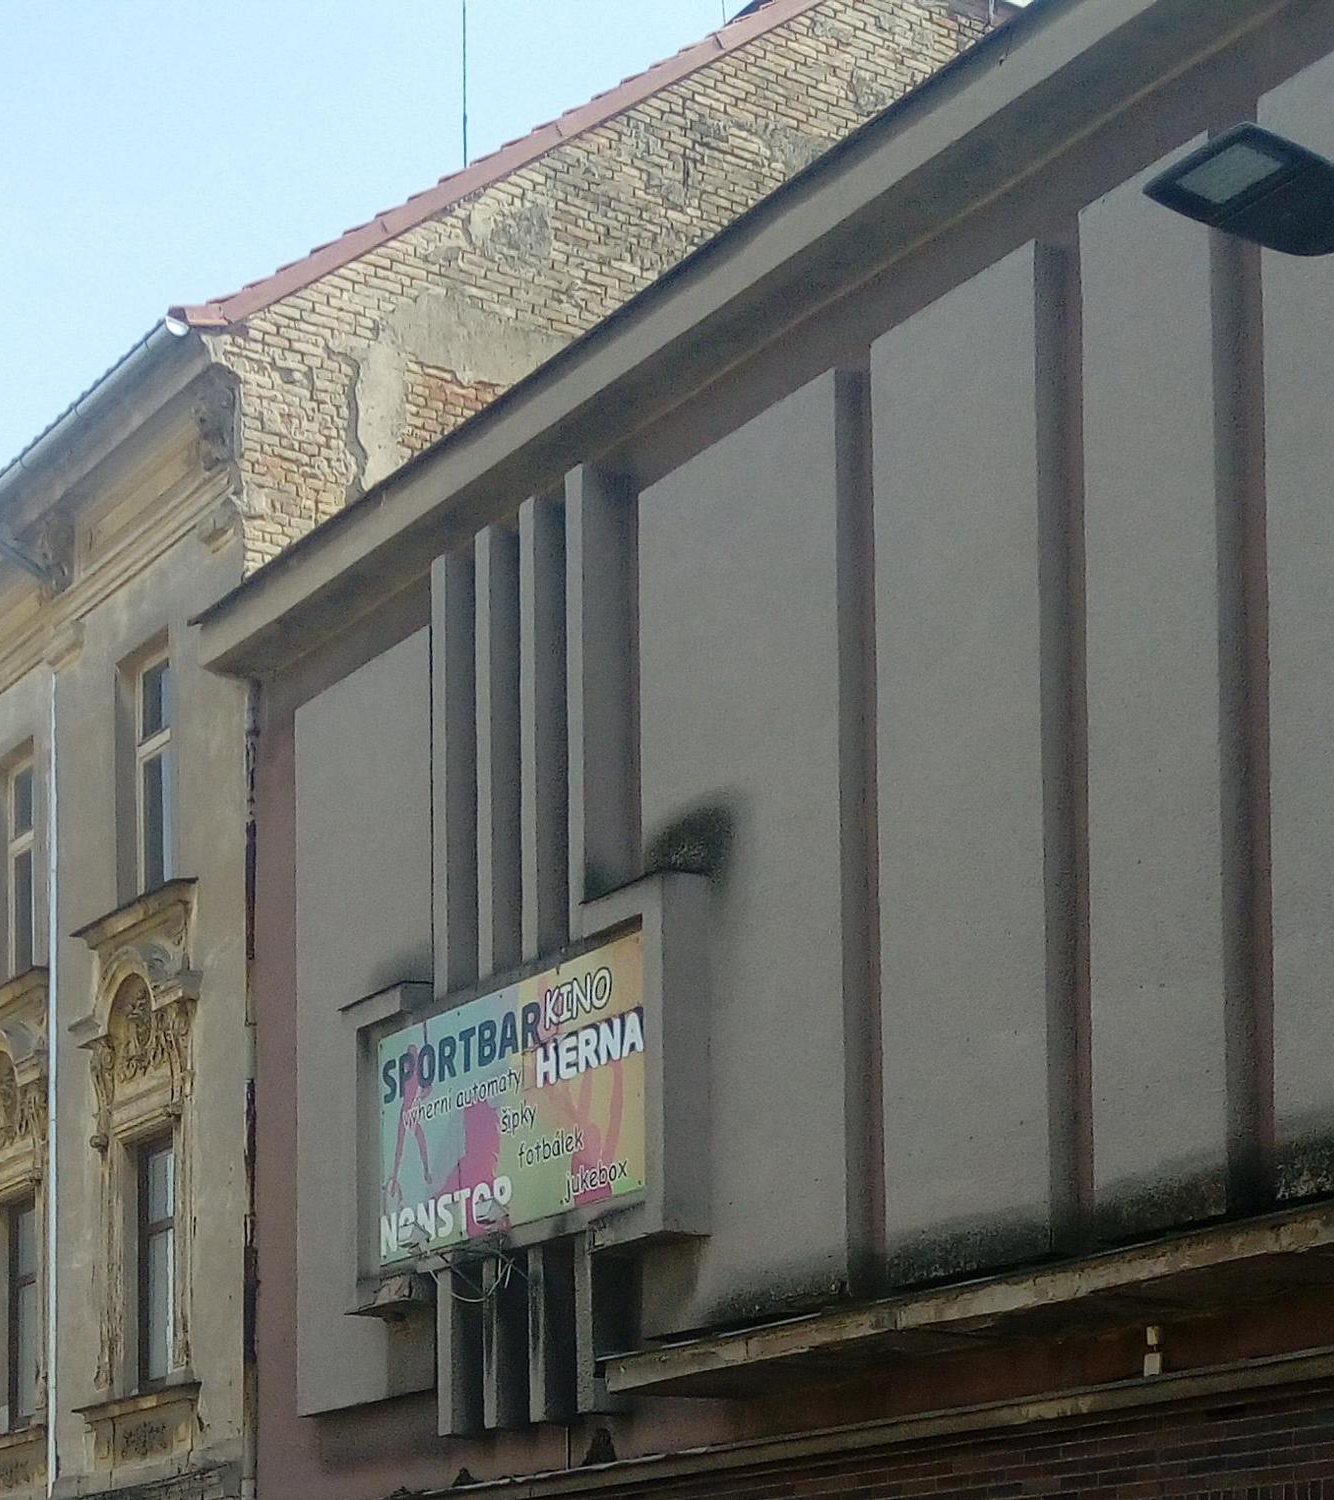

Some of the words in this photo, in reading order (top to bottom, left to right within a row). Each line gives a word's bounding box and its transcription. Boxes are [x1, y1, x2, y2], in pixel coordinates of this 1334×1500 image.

[544, 966, 613, 1030] KINO
[383, 1001, 542, 1104] SPORTBAR
[536, 1008, 645, 1088] HERNA
[456, 1067, 522, 1109] automaty
[500, 1100, 537, 1135] šipky
[518, 1124, 584, 1168] fotbálek
[564, 1159, 629, 1204] jukebox
